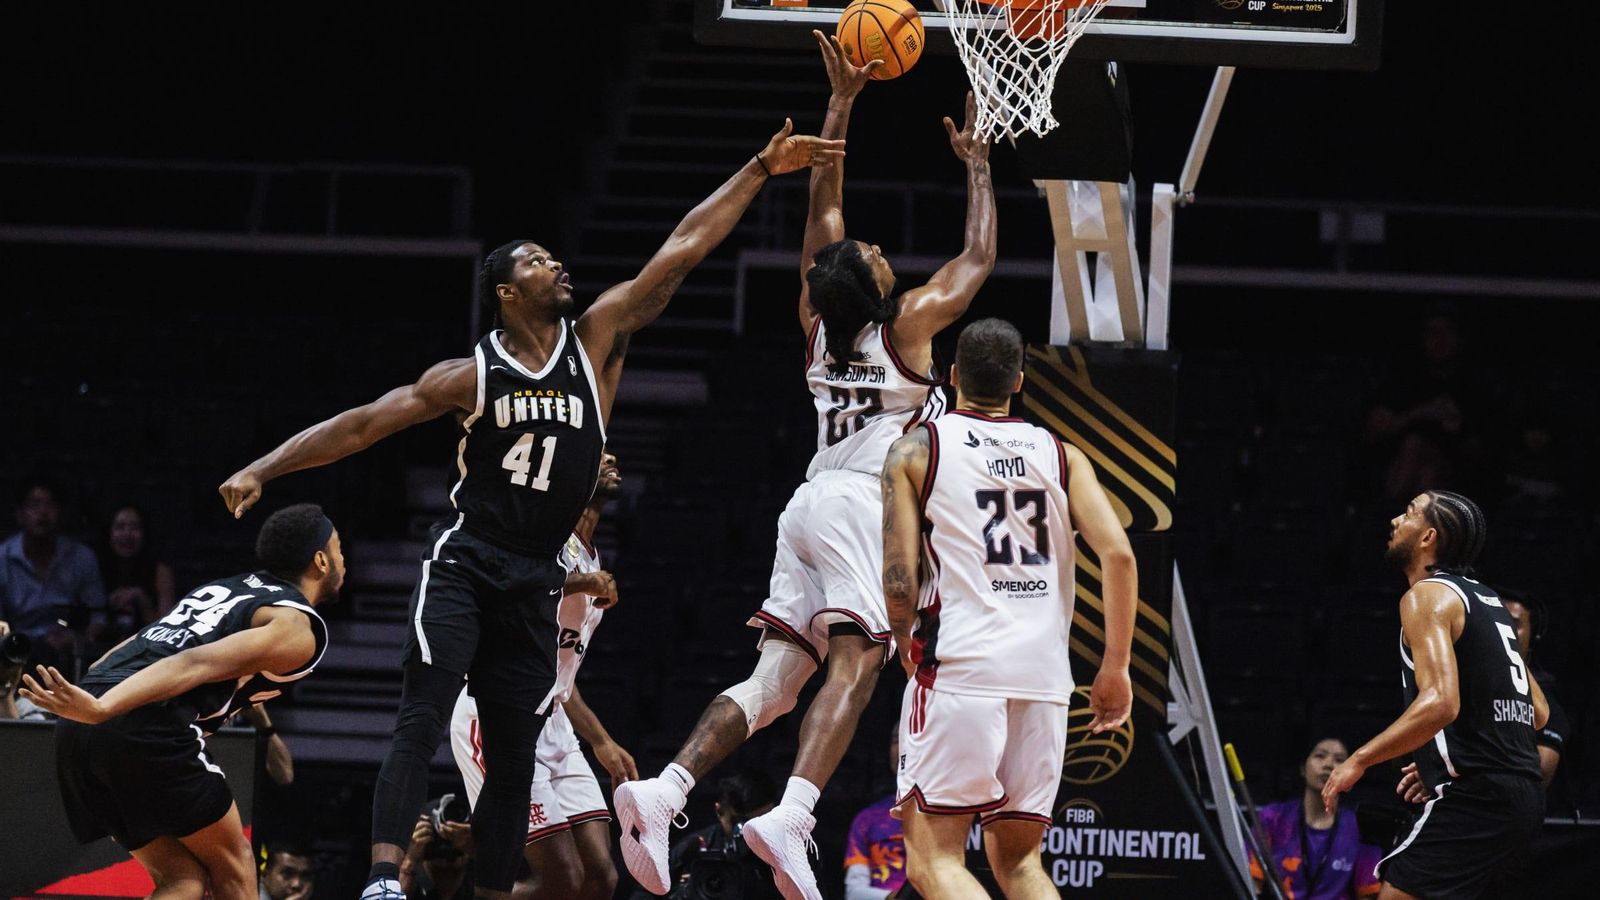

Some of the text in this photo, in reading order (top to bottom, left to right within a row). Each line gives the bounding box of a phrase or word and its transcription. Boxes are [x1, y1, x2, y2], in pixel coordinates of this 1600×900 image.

[1248, 1, 1266, 11] CUP
[906, 35, 917, 52] FIBA
[513, 389, 565, 399] NBAGL
[494, 394, 584, 429] UNITED
[502, 432, 557, 492] 41
[986, 456, 1025, 478] KAYO
[975, 488, 1051, 565] 23
[991, 579, 1047, 592] $MENGO
[158, 585, 256, 636] 24
[1494, 621, 1529, 696] 5
[1066, 808, 1095, 824] FIBA
[1052, 858, 1104, 888] CUP
